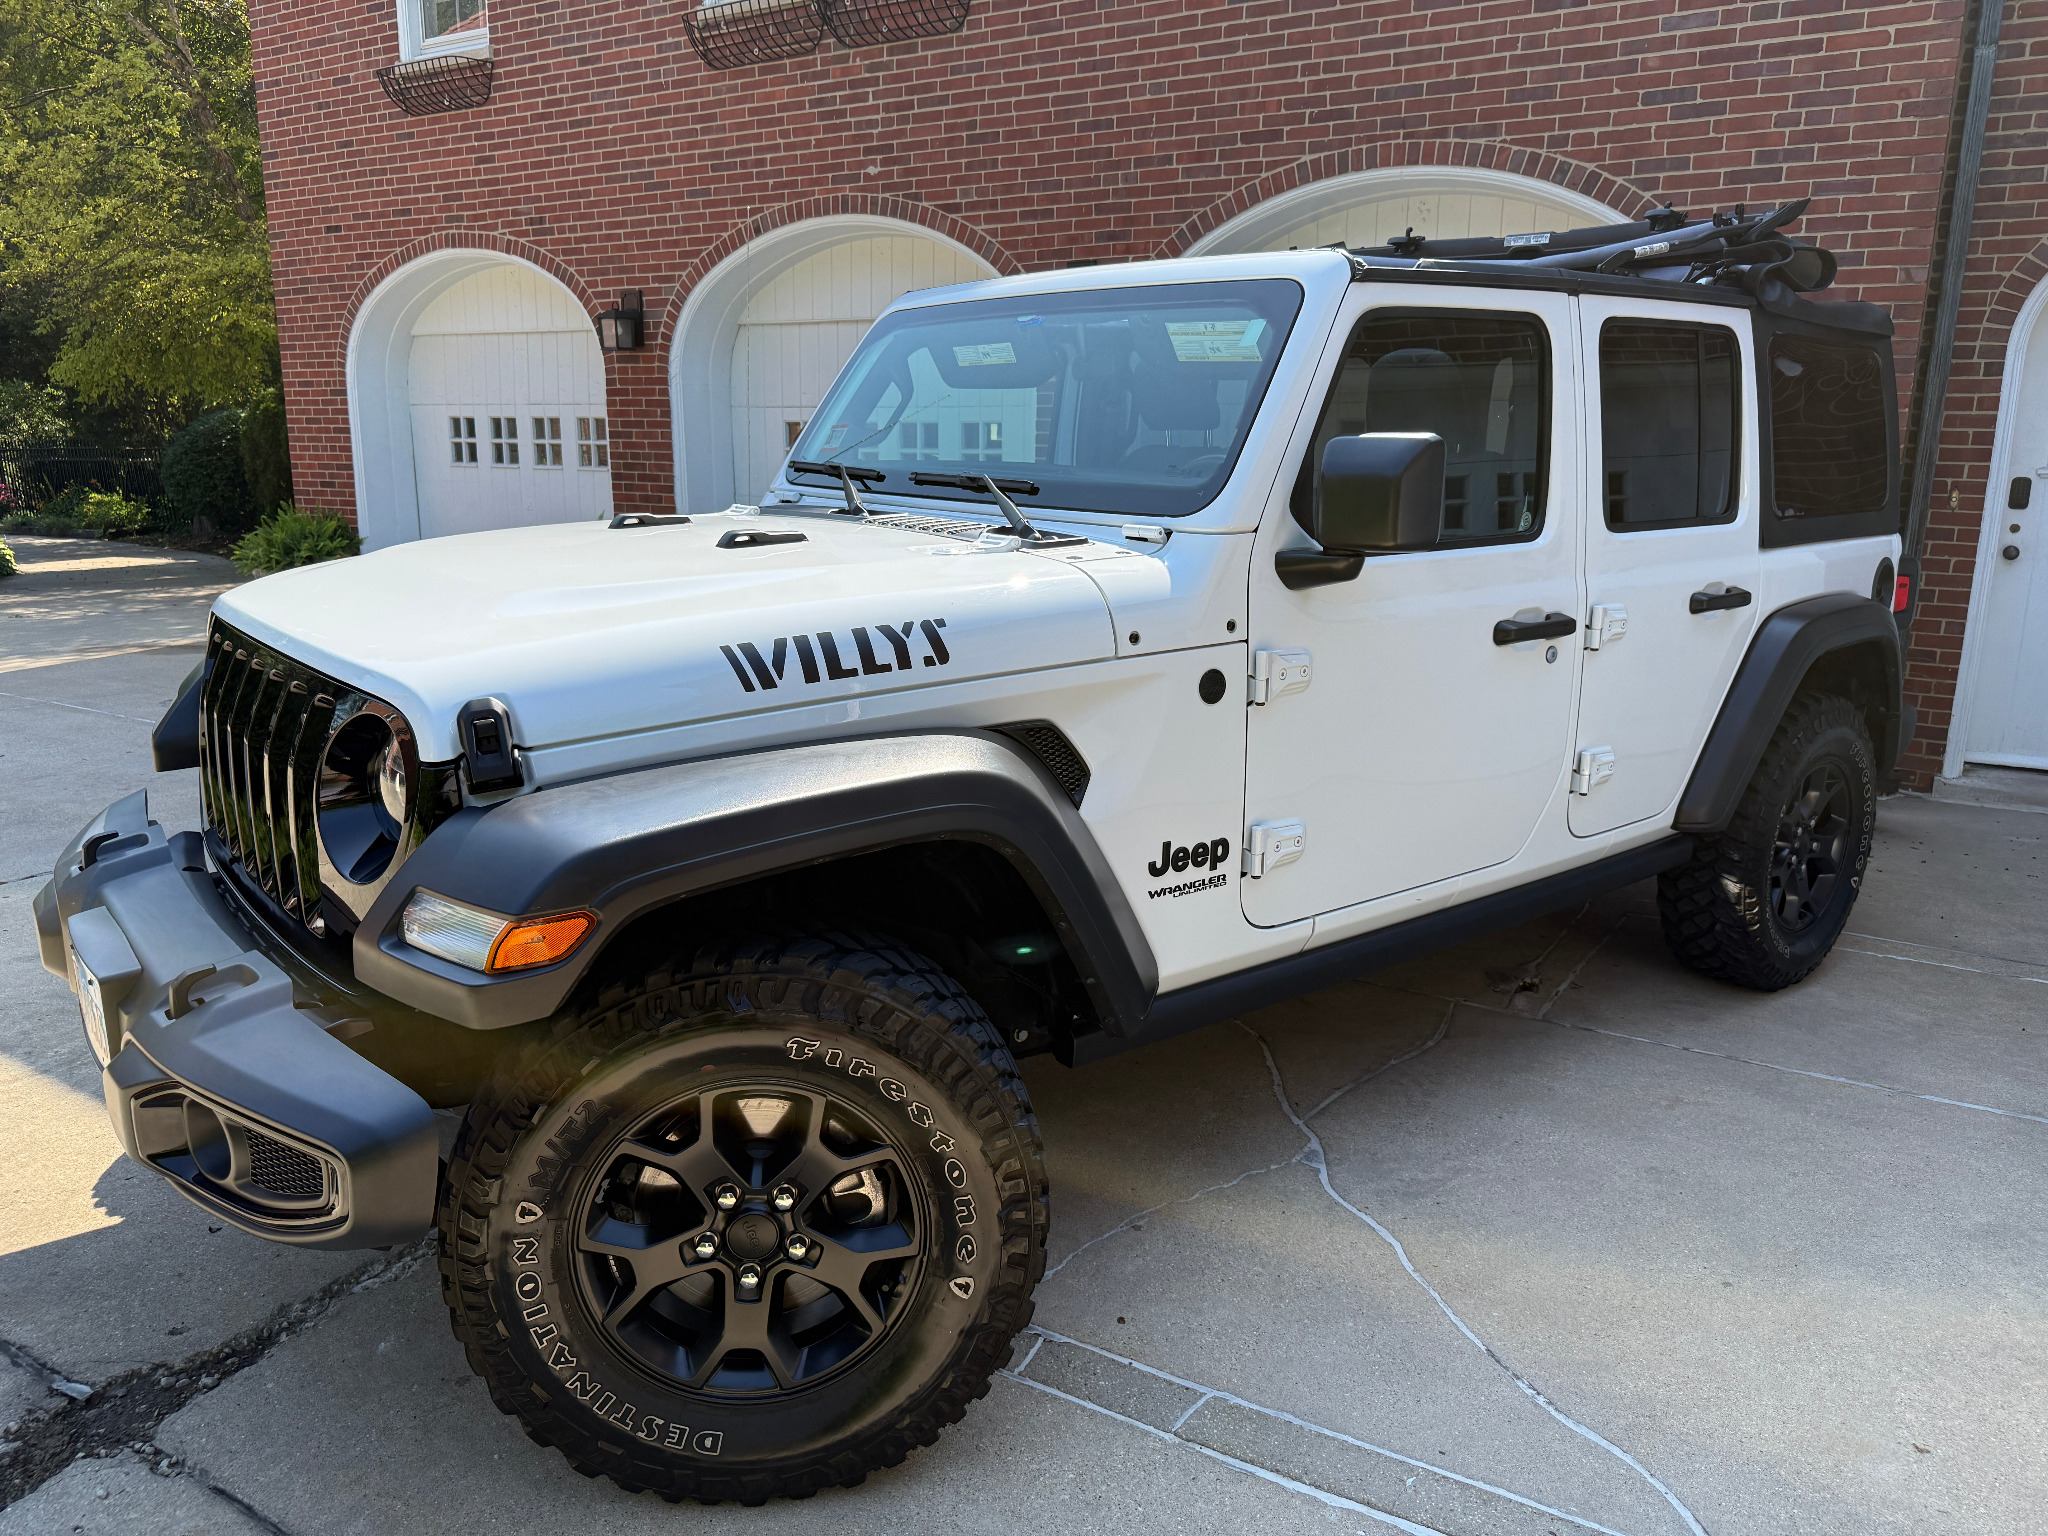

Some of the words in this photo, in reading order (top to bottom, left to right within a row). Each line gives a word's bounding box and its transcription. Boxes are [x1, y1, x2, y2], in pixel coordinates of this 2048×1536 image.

[719, 617, 950, 692] WILLYS
[1148, 837, 1229, 877] Jeep
[1147, 873, 1227, 900] WRANGLER
[1173, 881, 1227, 898] UNLIMITED
[785, 1037, 977, 1264] Firestone
[512, 1237, 724, 1456] DESTINATION
